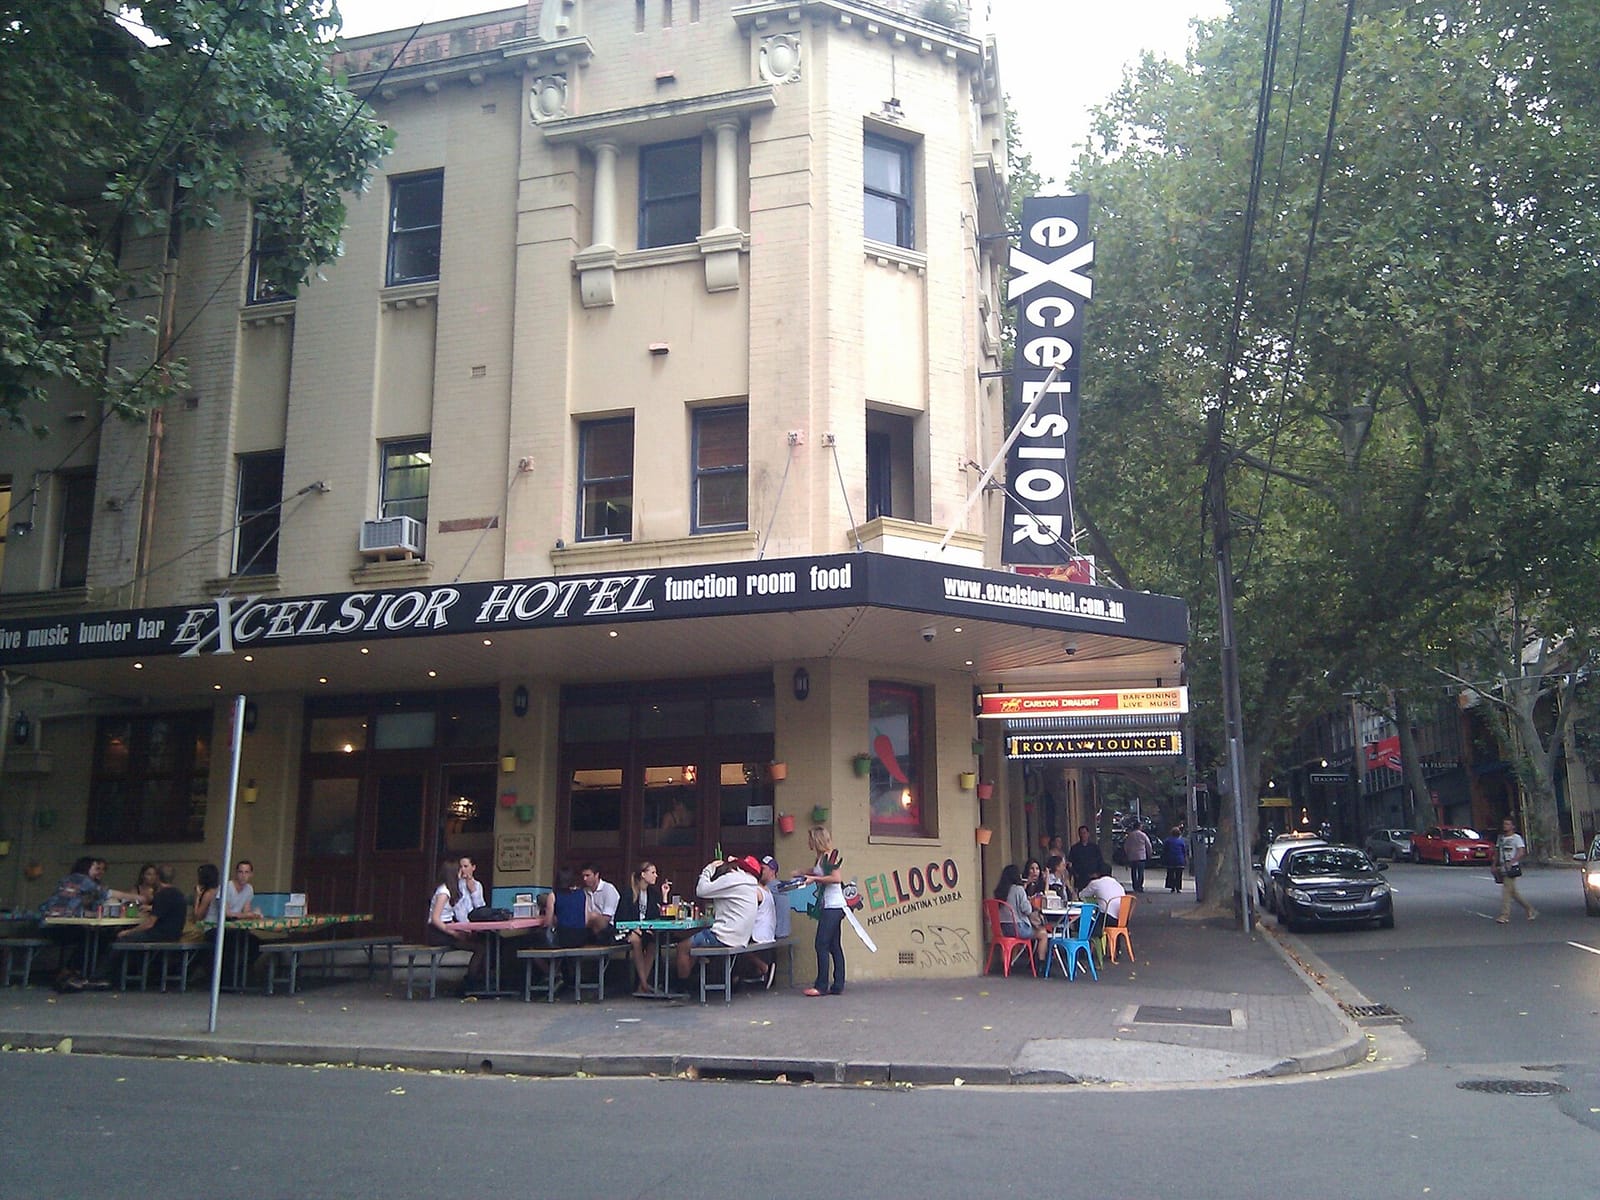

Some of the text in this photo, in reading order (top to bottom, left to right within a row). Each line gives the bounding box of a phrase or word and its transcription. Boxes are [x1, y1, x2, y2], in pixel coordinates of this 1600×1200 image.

[944, 578, 1124, 618] www.excelsiorhotel.com.au
[0, 563, 852, 658] ive music bunker bar EXCELSIOR HOTEL function room food
[1023, 698, 1100, 707] CARLTON DRAUGHT
[1145, 691, 1178, 699] DINING
[1149, 700, 1178, 708] MUSIC
[1022, 738, 1168, 752] ROYAL LOUNGE
[891, 859, 959, 903] LOCO
[867, 910, 902, 926] MEXICAN
[902, 901, 932, 914] CANTINA
